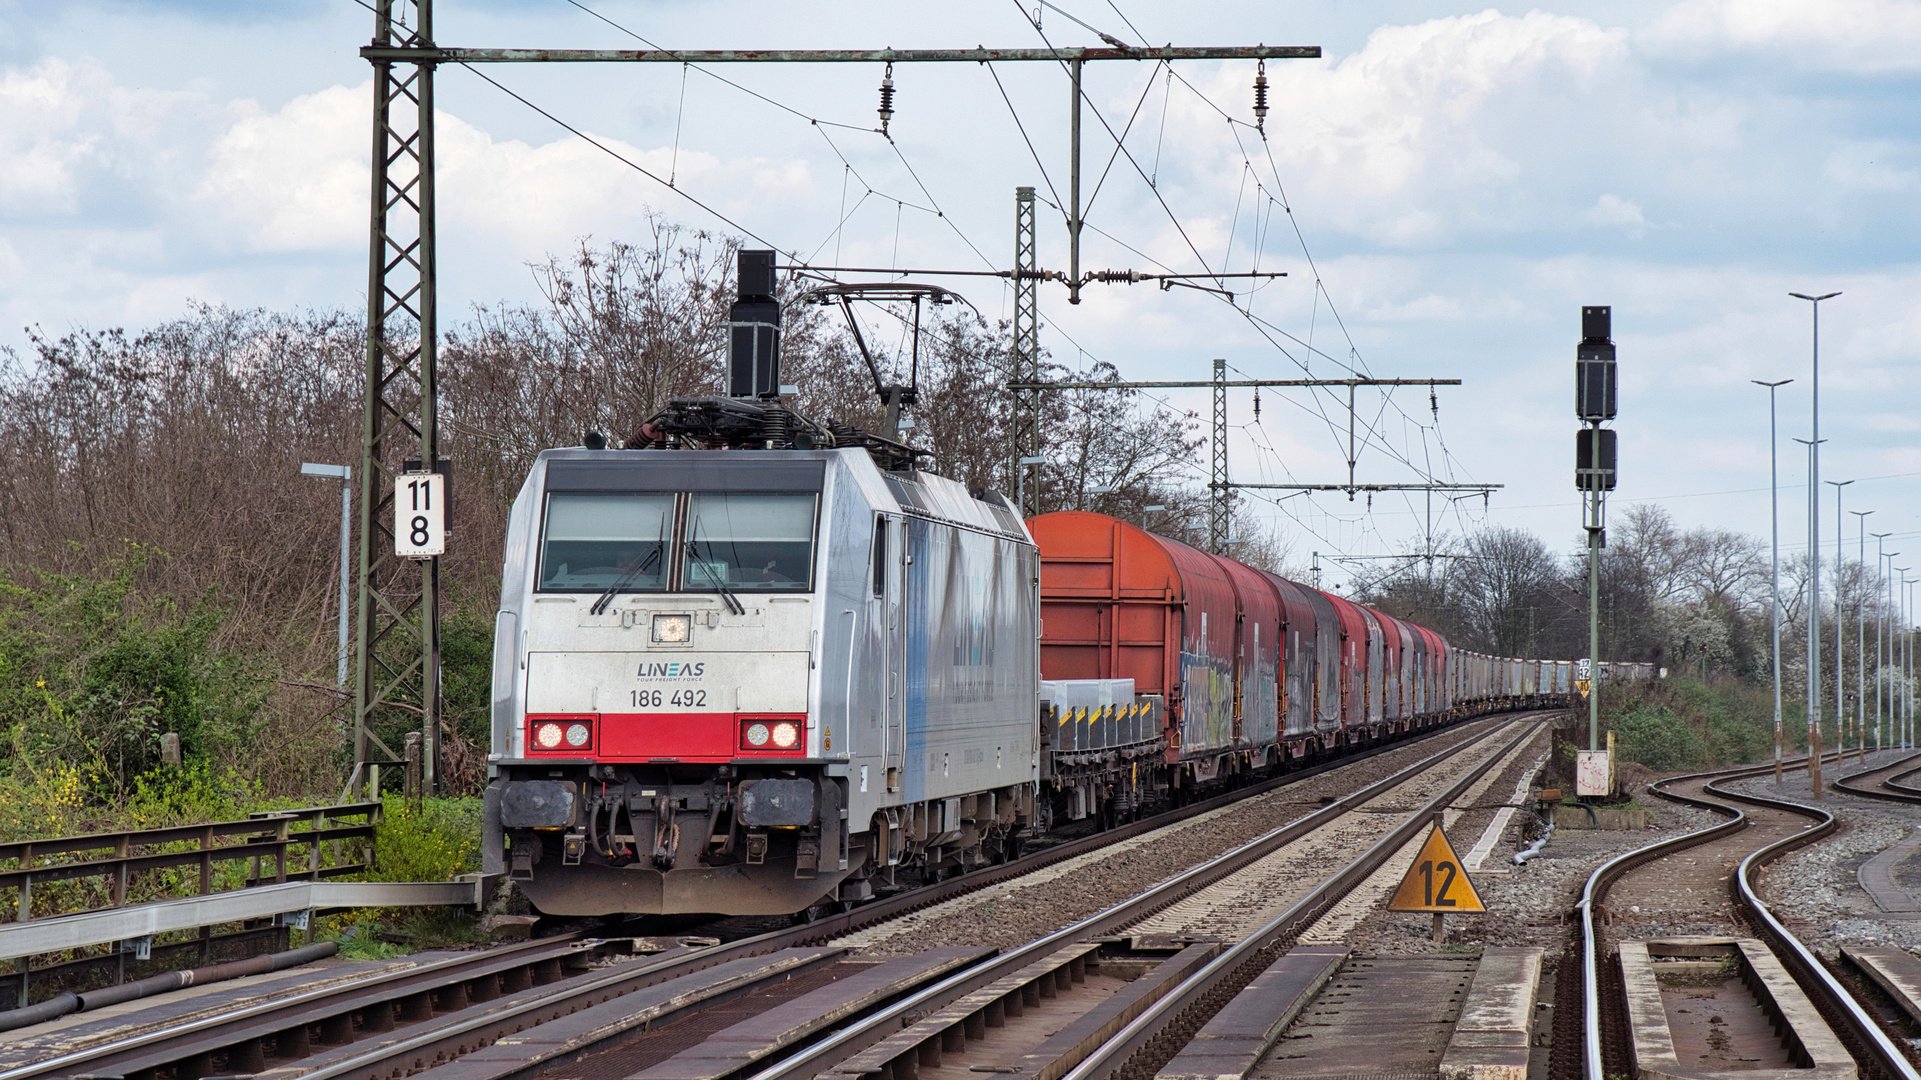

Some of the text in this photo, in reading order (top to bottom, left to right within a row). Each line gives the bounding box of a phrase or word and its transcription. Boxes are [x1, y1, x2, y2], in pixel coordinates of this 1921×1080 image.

[408, 480, 430, 511] 11
[410, 515, 429, 547] 8
[637, 662, 705, 677] LINEAS
[630, 689, 707, 707] 186 492
[1418, 860, 1457, 907] 12
